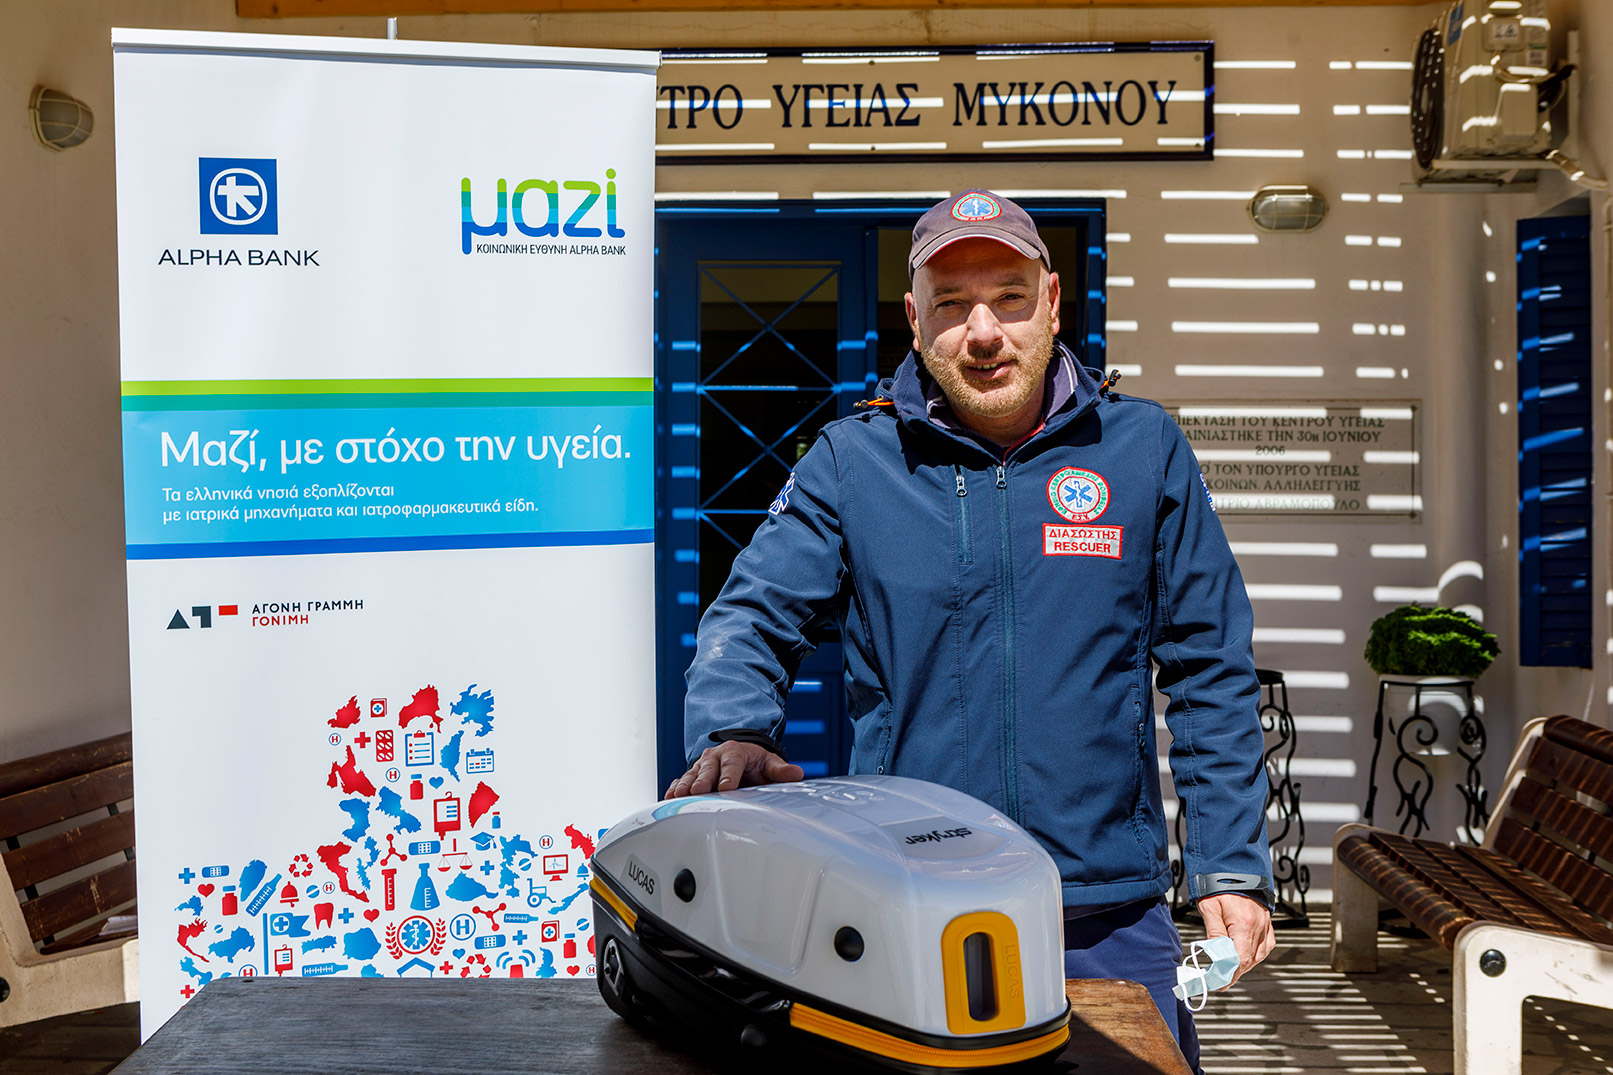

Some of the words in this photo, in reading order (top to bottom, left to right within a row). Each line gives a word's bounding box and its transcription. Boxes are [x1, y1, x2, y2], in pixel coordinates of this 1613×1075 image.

[657, 84, 743, 130] ΤΡΟ
[772, 83, 922, 128] ΥΓΕΙΑΣ
[952, 80, 1177, 127] ΜΥΚΟΝΟΥ
[476, 243, 528, 254] ΚΟΙΝΩΝΙΚΗ
[530, 244, 568, 255] ΕΥΘΥΝΗ
[569, 245, 600, 255] ALPHA
[601, 245, 627, 256] BANK
[158, 249, 242, 266] ALPHA
[248, 249, 320, 267] BANK
[1241, 416, 1268, 427] ΤΟΥ
[1272, 416, 1335, 427] ΚΕΝΤΡΟΥ
[1339, 416, 1384, 428] ΥΓΕΙΑΣ
[1185, 429, 1263, 441] ΑΙΝΙΑΣΤΗΚΕ
[1266, 430, 1294, 442] ΤΗΝ
[1322, 431, 1382, 442] ΙΟΥΝΙΟΥ
[161, 428, 267, 474] Μαζί,
[280, 438, 325, 474] με
[335, 427, 445, 464] στόχο
[455, 435, 516, 462] την
[527, 424, 631, 469] υγεία.
[1255, 444, 1286, 456] 2006
[1213, 463, 1242, 475] ΤΟΝ
[1246, 464, 1311, 476] ΥΠΟΥΡΓΟ
[1314, 465, 1360, 477] ΥΓΕΙΑΣ
[162, 487, 181, 502] Τα
[186, 485, 253, 502] ελληνικά
[257, 485, 299, 500] νησιά
[303, 483, 395, 500] εξοπλίζονται
[163, 509, 182, 525] με
[186, 505, 240, 523] ιατρικά
[244, 504, 333, 523] μηχανήματα
[337, 505, 358, 517] και
[362, 499, 501, 519] ιατροφαρμακευτικά
[505, 498, 539, 512] είδη.
[1049, 528, 1117, 540] ΔΙΑΣΩΣΤΗΣ
[1054, 541, 1111, 553] RESCUER
[251, 602, 301, 615] ΑΓΟΝΗ
[307, 599, 364, 612] ΓΡΑΜΜΗ
[252, 614, 309, 627] ΓΟΝΙΜΗ
[905, 827, 973, 844] stryker
[628, 861, 655, 895] LUCAS
[1005, 944, 1020, 1000] LUCAS
